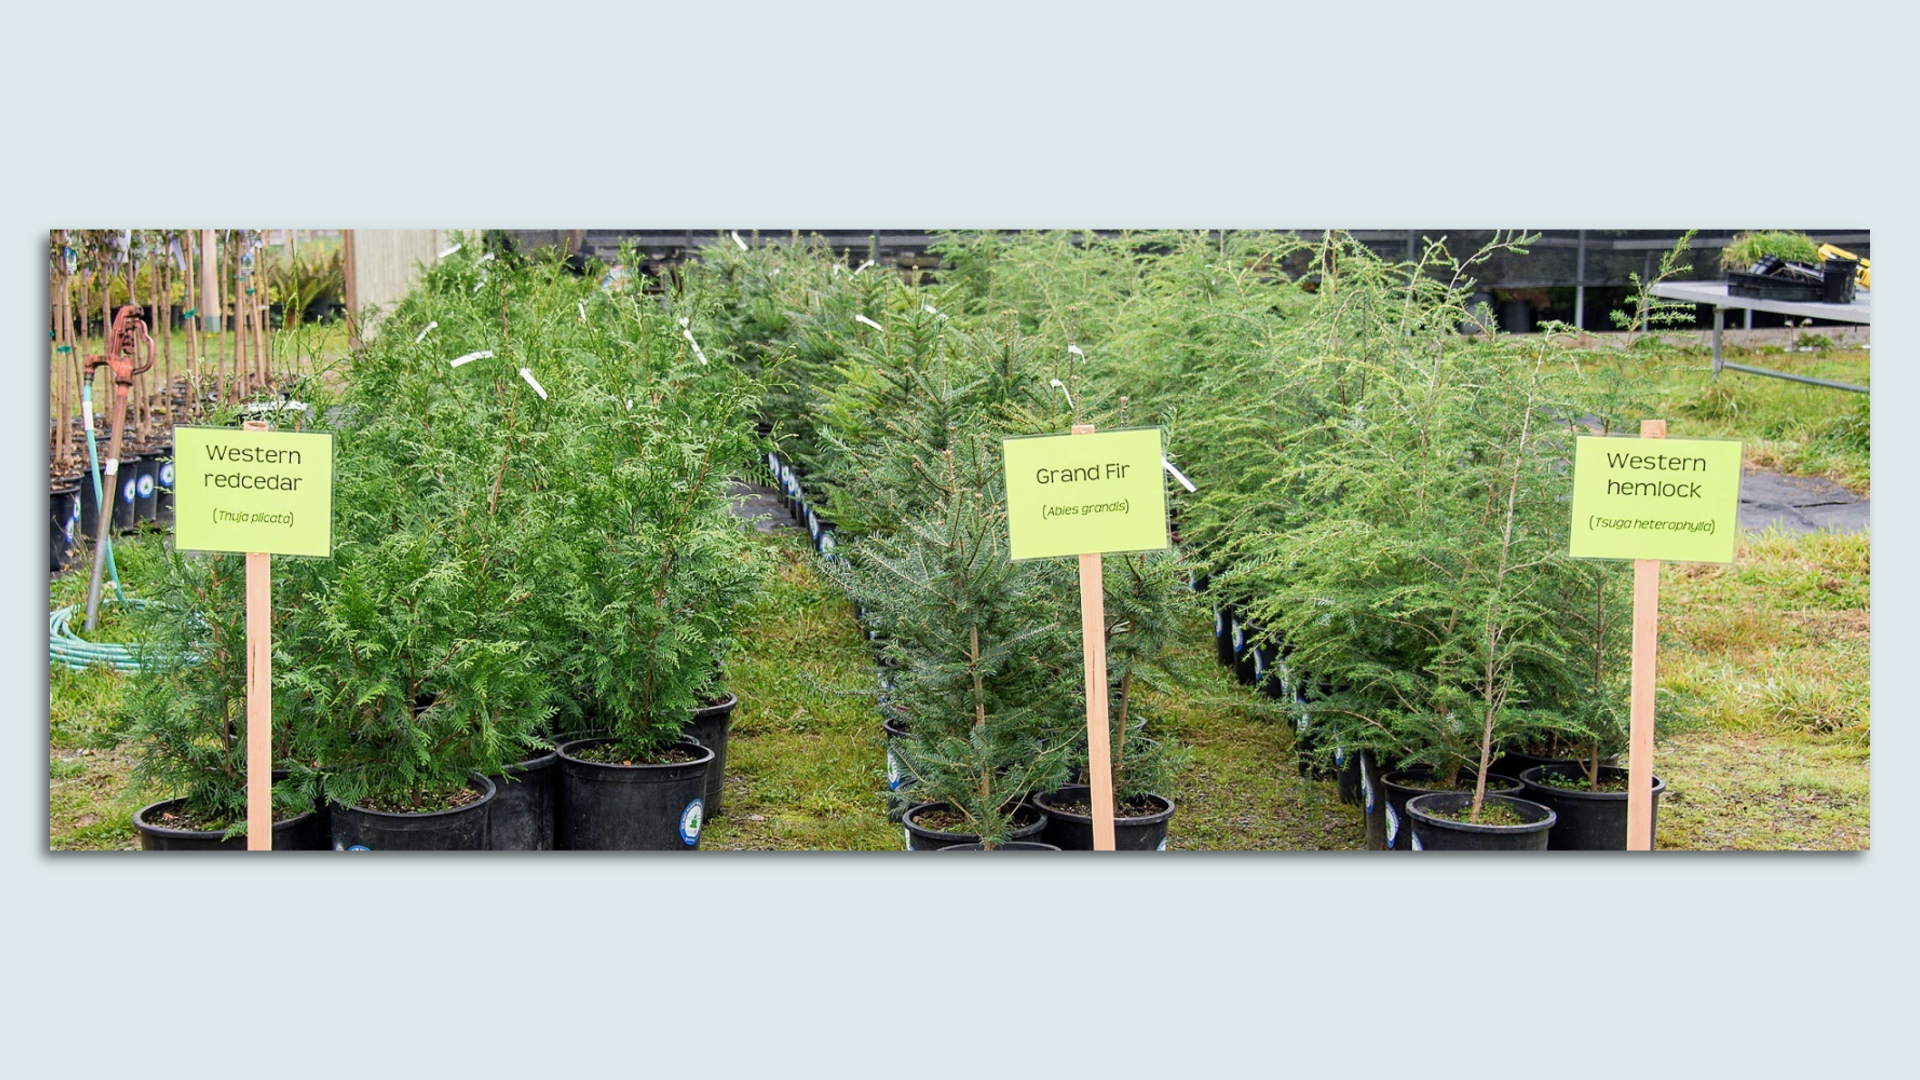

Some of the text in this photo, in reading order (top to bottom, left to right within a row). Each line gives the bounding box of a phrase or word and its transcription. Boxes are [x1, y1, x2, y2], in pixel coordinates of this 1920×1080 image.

[205, 445, 301, 465] Western
[1606, 452, 1707, 472] Western
[204, 473, 303, 491] redcedar
[1036, 463, 1131, 485] Grand Fir
[1607, 479, 1702, 499] hemlock
[213, 508, 295, 528] (Thuja plicata)
[1042, 498, 1130, 520] (Abies grandis)
[1589, 515, 1716, 535] (Tsuga heterophylla)
